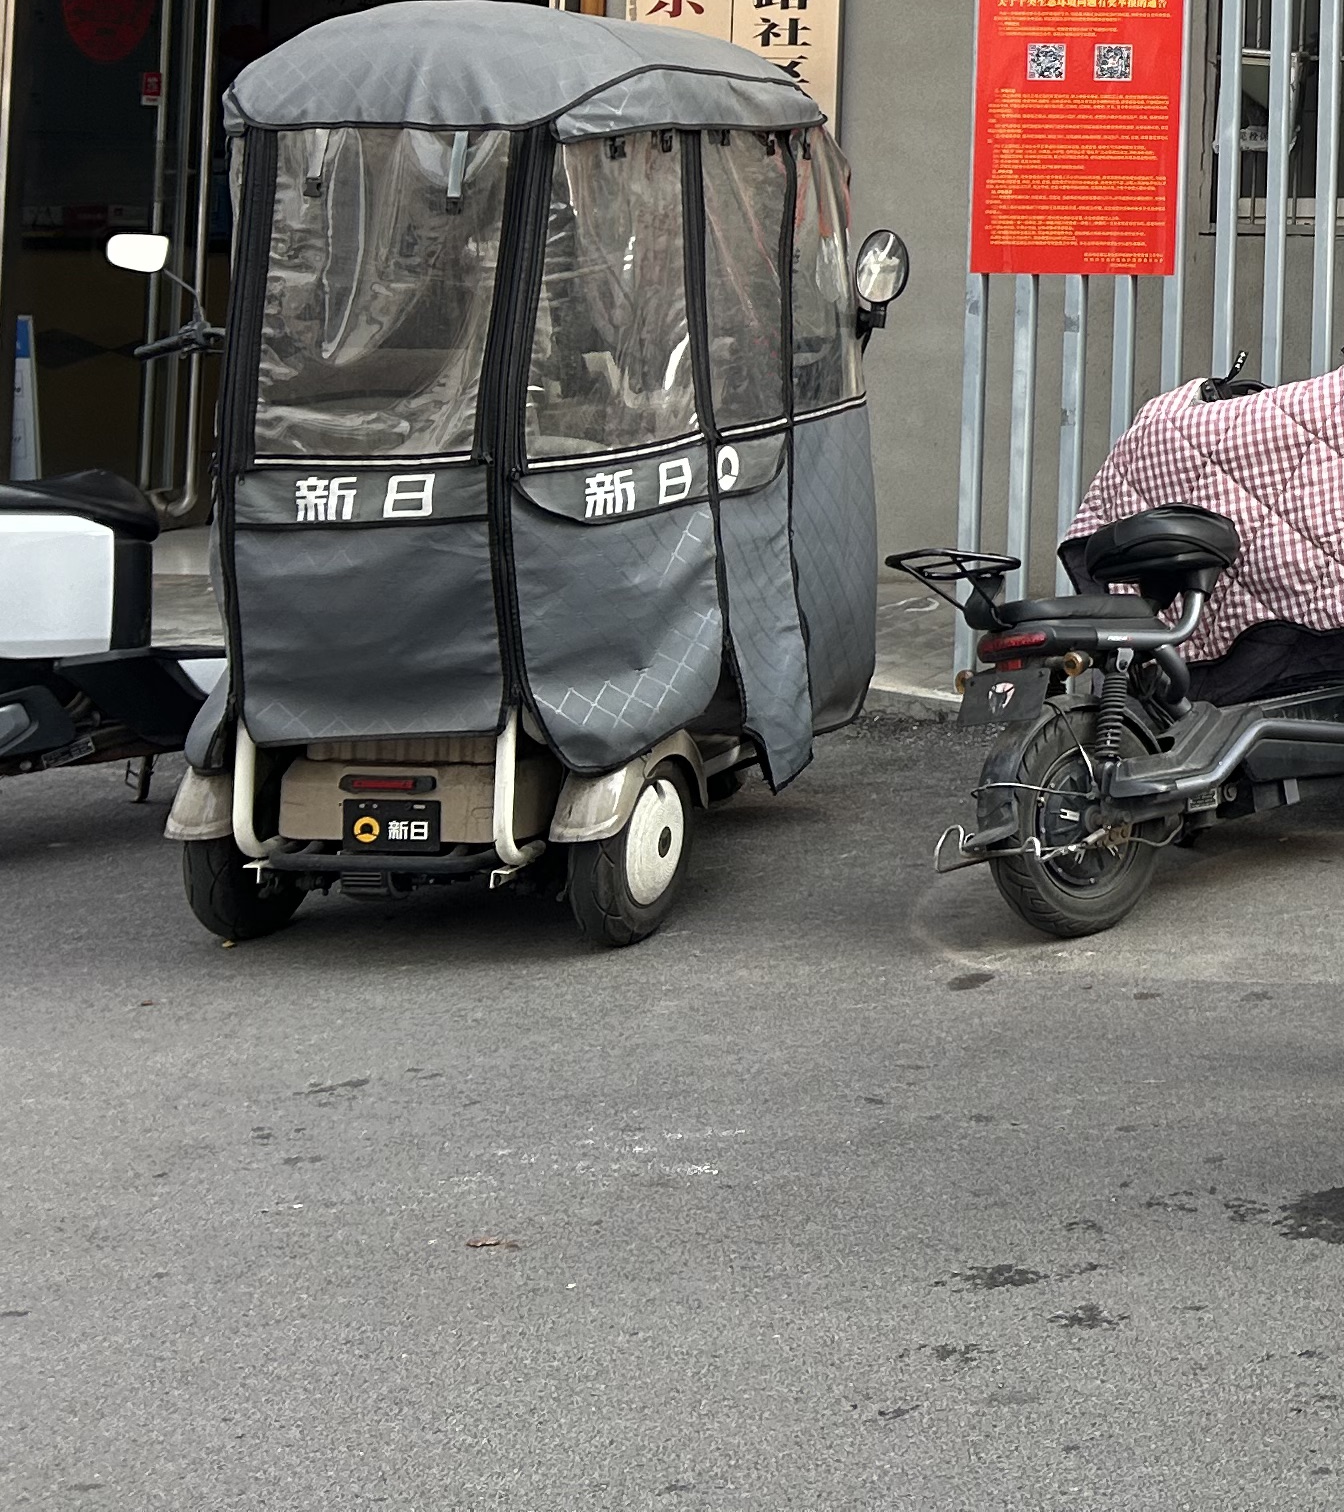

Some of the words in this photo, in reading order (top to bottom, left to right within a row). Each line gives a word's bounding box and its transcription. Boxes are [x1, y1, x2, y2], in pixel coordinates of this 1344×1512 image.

[294, 473, 436, 522] 新日
[584, 457, 693, 519] 新日
[387, 820, 429, 840] 新日
